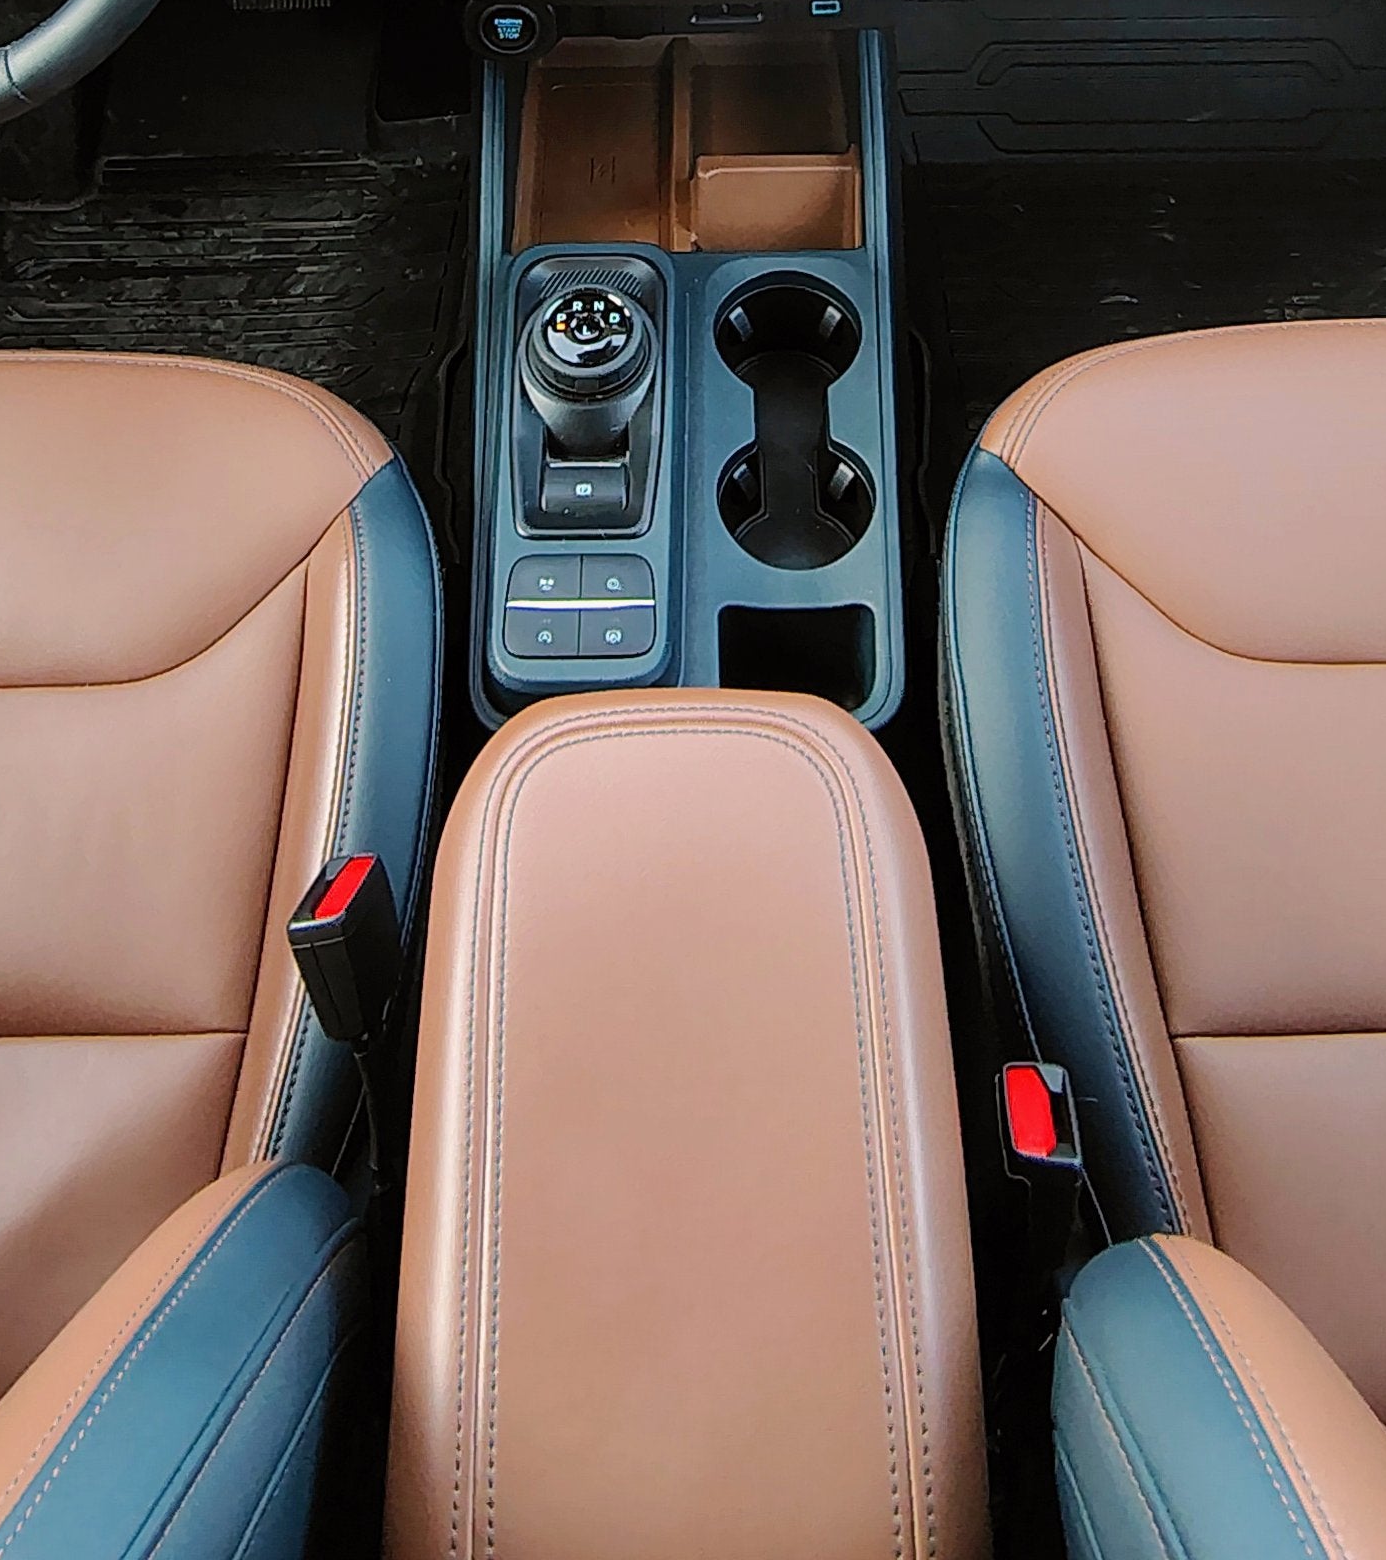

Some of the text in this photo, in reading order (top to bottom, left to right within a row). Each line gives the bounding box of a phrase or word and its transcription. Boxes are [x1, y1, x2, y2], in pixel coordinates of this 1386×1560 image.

[572, 300, 583, 311] R
[593, 300, 605, 311] N
[556, 313, 567, 323] P
[608, 312, 621, 323] D
[582, 325, 591, 335] L
